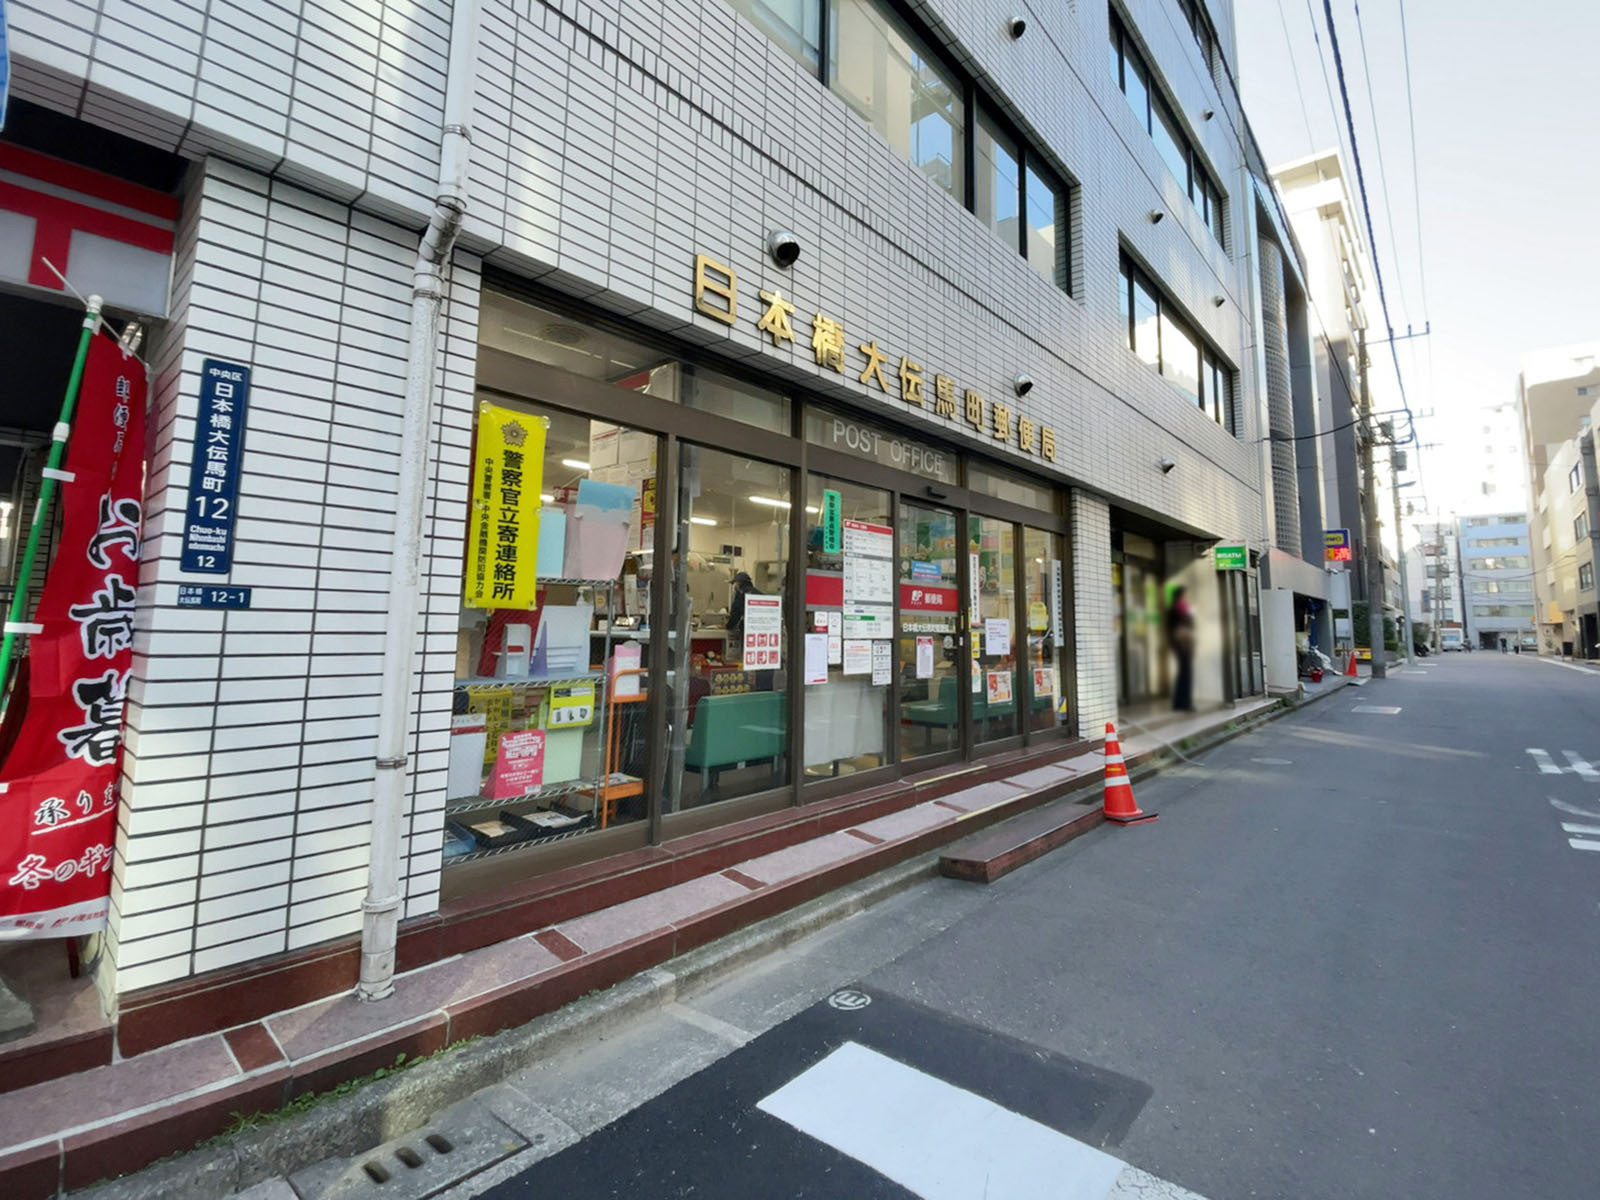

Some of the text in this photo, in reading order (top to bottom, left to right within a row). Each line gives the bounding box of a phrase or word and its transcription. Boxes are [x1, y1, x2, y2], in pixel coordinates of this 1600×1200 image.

[695, 254, 1056, 462] 日本橋大伝馬町郵便局
[209, 368, 242, 382] 中央区
[202, 382, 234, 492] 日本橋大伝馬町
[832, 419, 943, 475] POST OFFICE
[195, 496, 229, 520] 12
[190, 525, 227, 535] Chuo-ku
[492, 449, 524, 601] 警察官立寄連絡所
[197, 555, 215, 567] 12
[211, 591, 245, 603] 12-1
